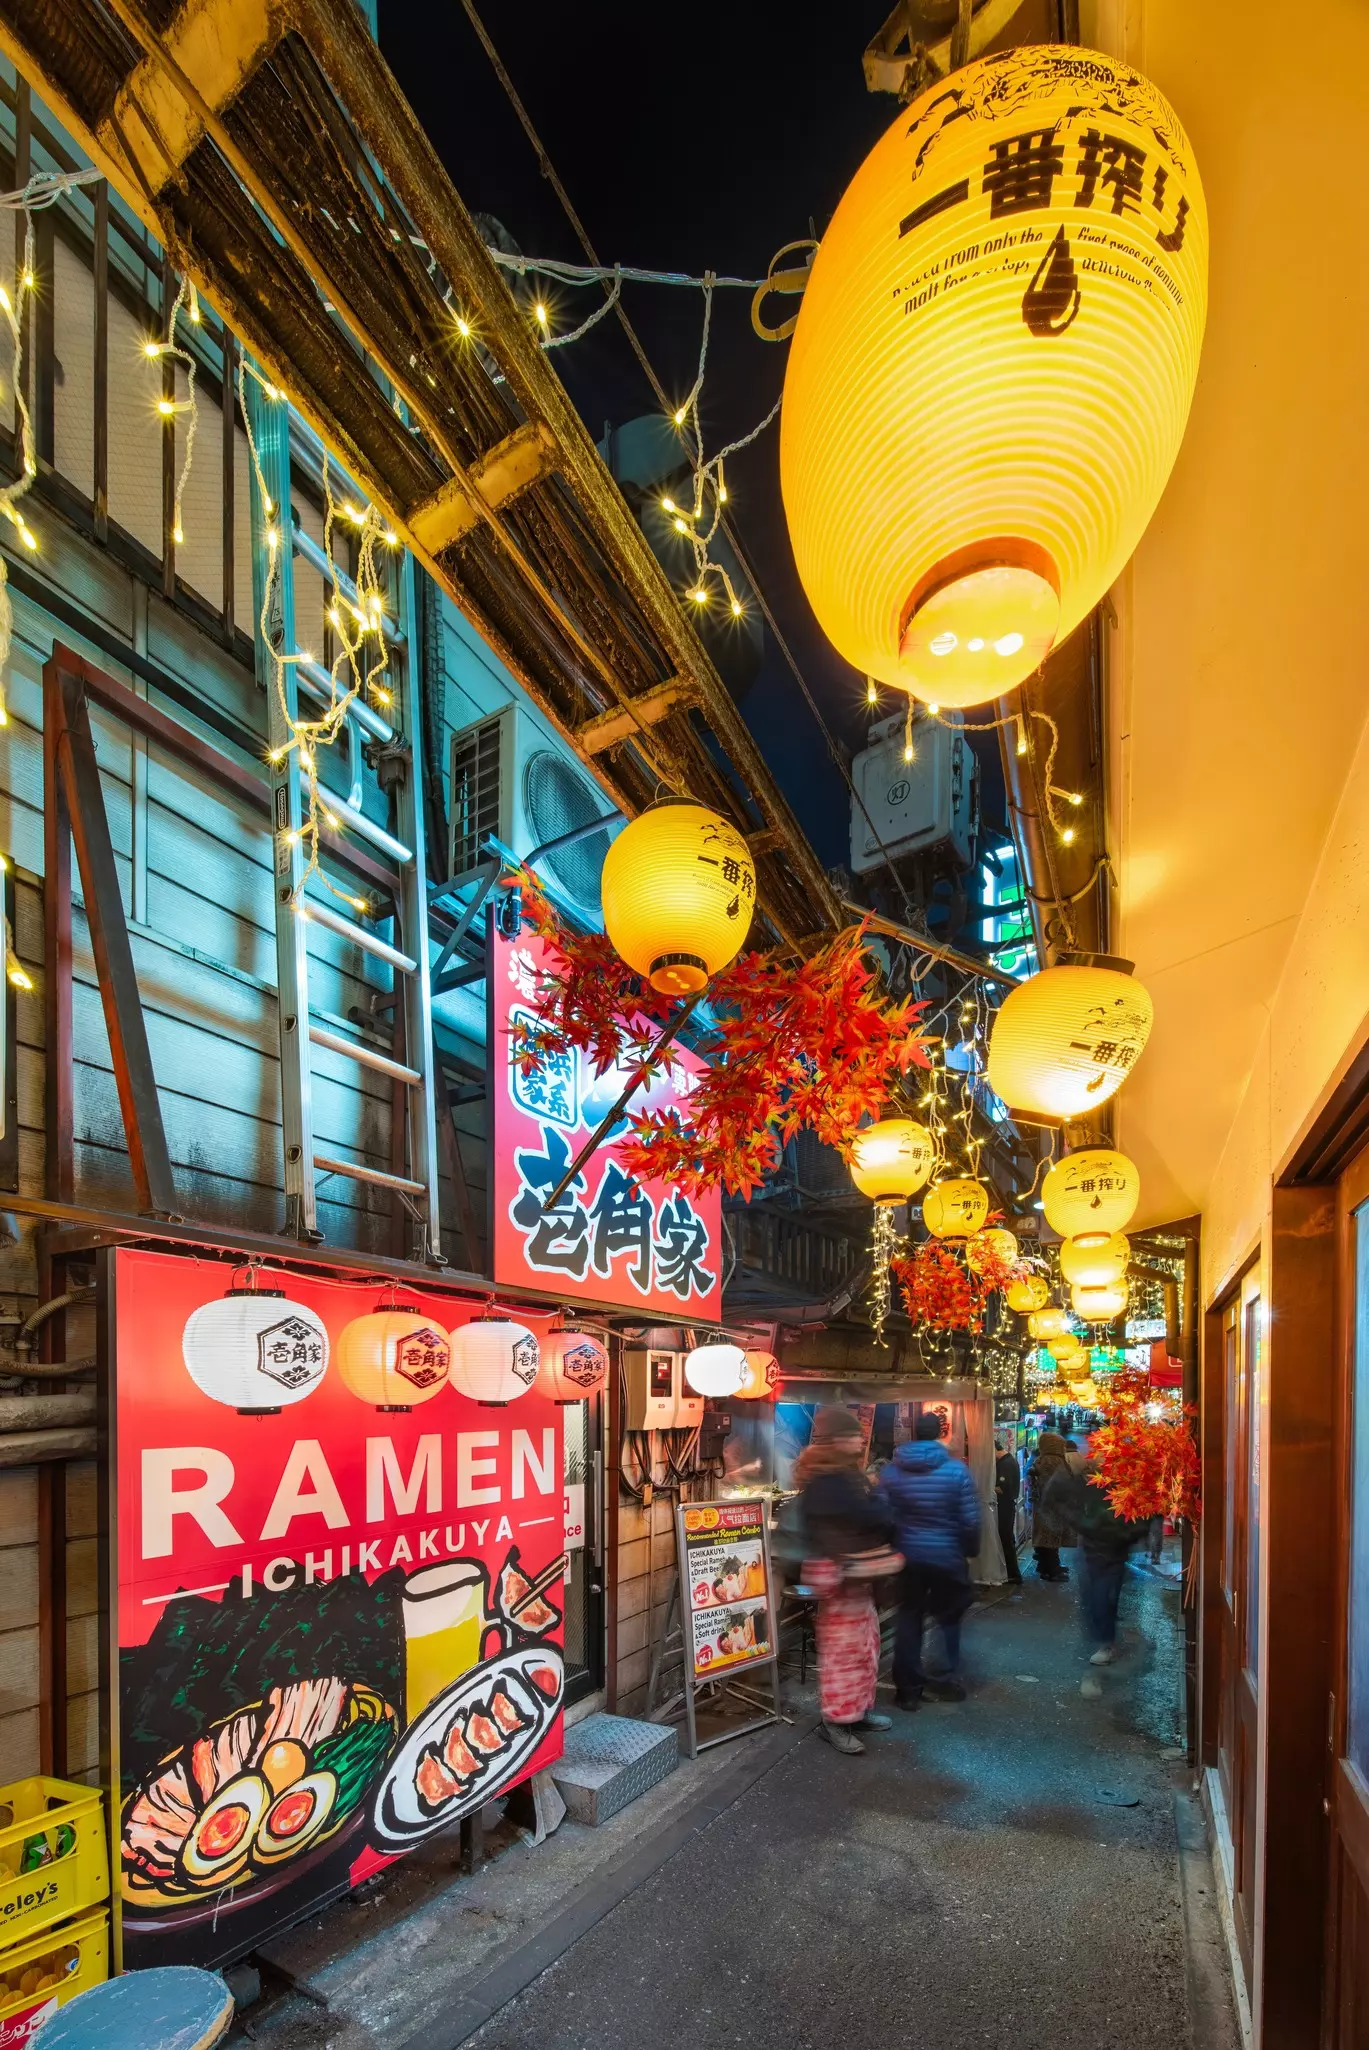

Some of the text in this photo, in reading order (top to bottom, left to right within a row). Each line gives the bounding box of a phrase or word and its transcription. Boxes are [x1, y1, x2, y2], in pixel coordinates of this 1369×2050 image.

[899, 127, 1191, 252] 一番搾り
[1065, 1177, 1126, 1193] 一番搾り
[267, 1341, 322, 1364] 壱角家
[403, 1348, 447, 1368] 壱角家
[568, 1359, 603, 1372] 壱角家
[141, 1427, 555, 1560] RAMEN
[720, 1528, 741, 1538] Ramen
[241, 1514, 513, 1599] ICHIKAKUYA
[690, 1547, 725, 1559] ICHIKAKUYA
[690, 1558, 708, 1568] Special
[694, 1607, 730, 1621] ICHIKAKUYA
[695, 1620, 713, 1630] Special
[711, 1626, 725, 1635] drink
[0, 1882, 58, 1915] eley's
